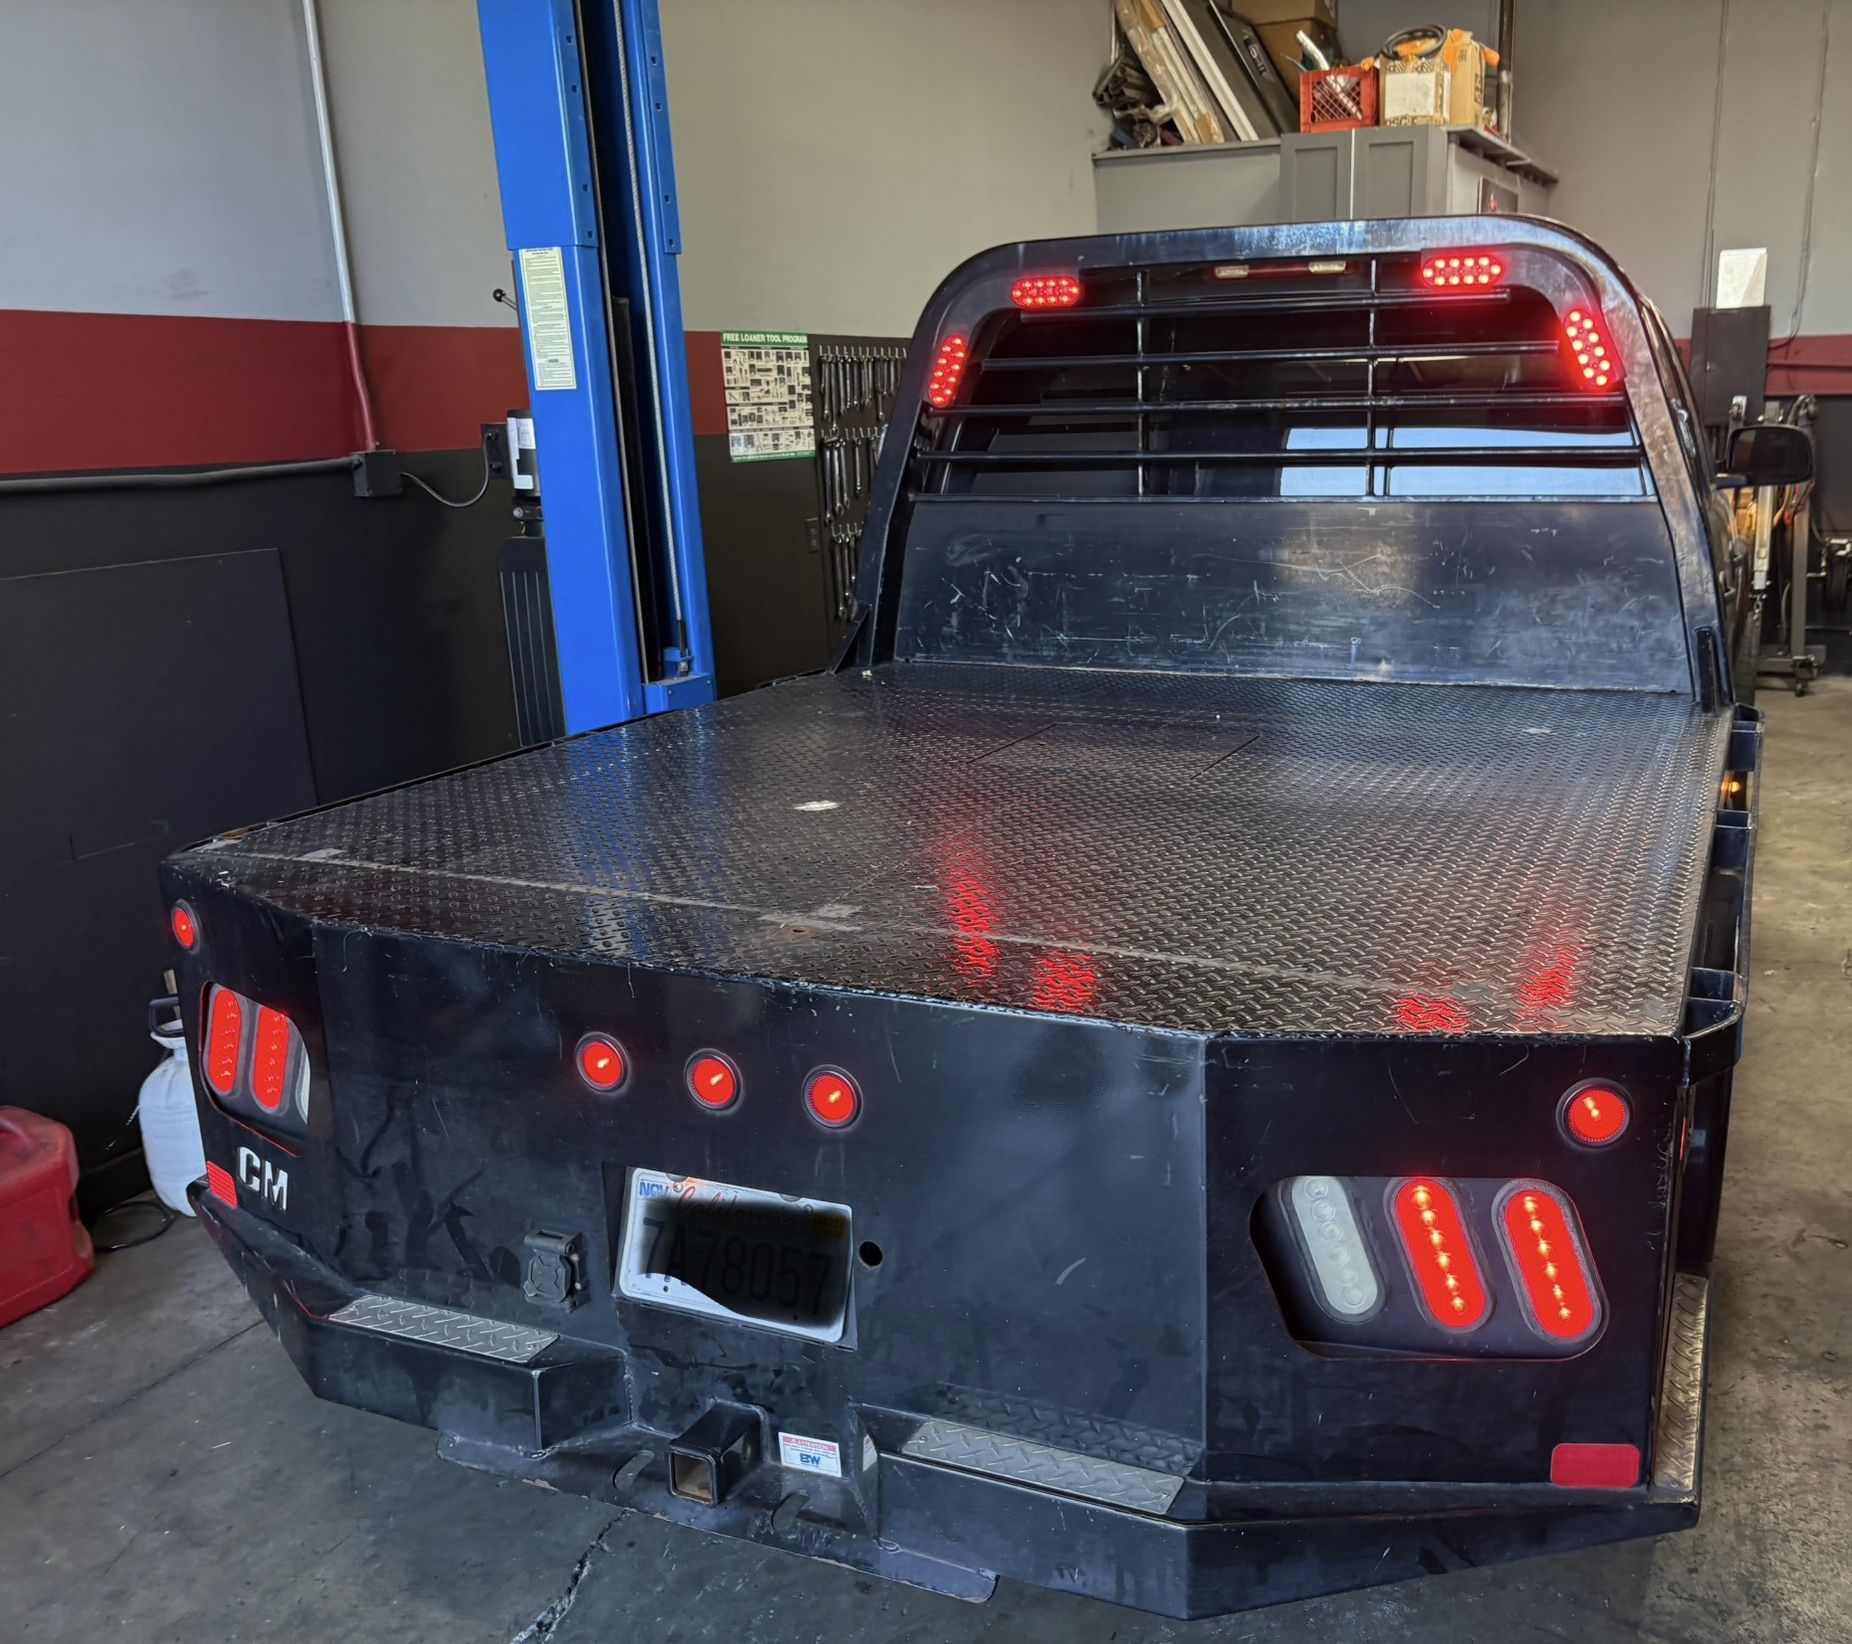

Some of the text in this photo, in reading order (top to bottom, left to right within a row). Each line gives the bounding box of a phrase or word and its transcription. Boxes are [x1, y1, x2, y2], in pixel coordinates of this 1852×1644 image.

[722, 333, 808, 344] FREE LOANER TOOL PROGRAM
[238, 1146, 289, 1211] CM
